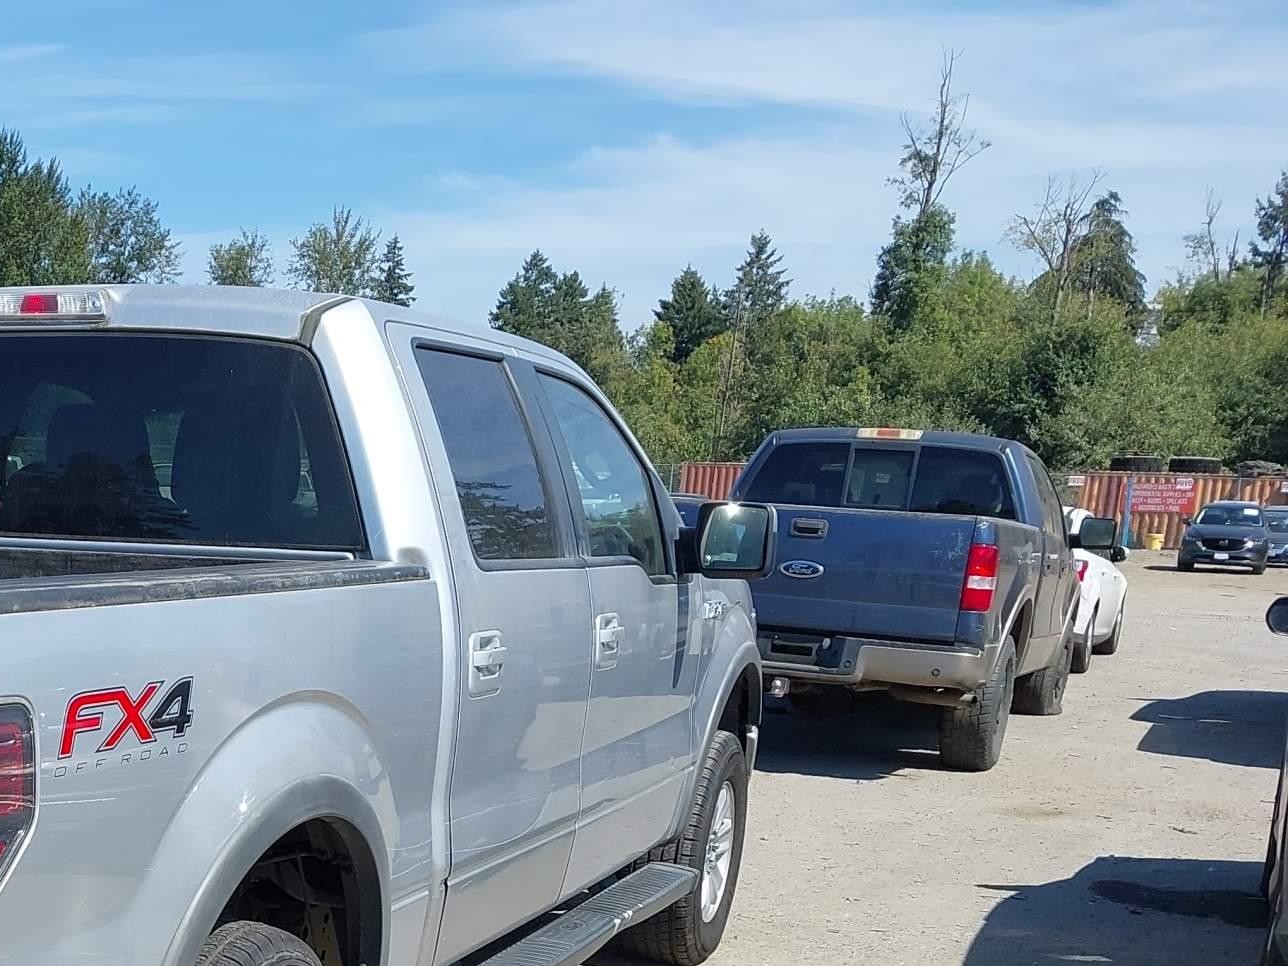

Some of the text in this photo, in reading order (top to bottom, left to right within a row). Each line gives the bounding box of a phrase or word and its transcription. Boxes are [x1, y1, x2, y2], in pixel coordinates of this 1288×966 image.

[57, 676, 193, 760] FX4
[54, 743, 188, 778] OFF ROAD
